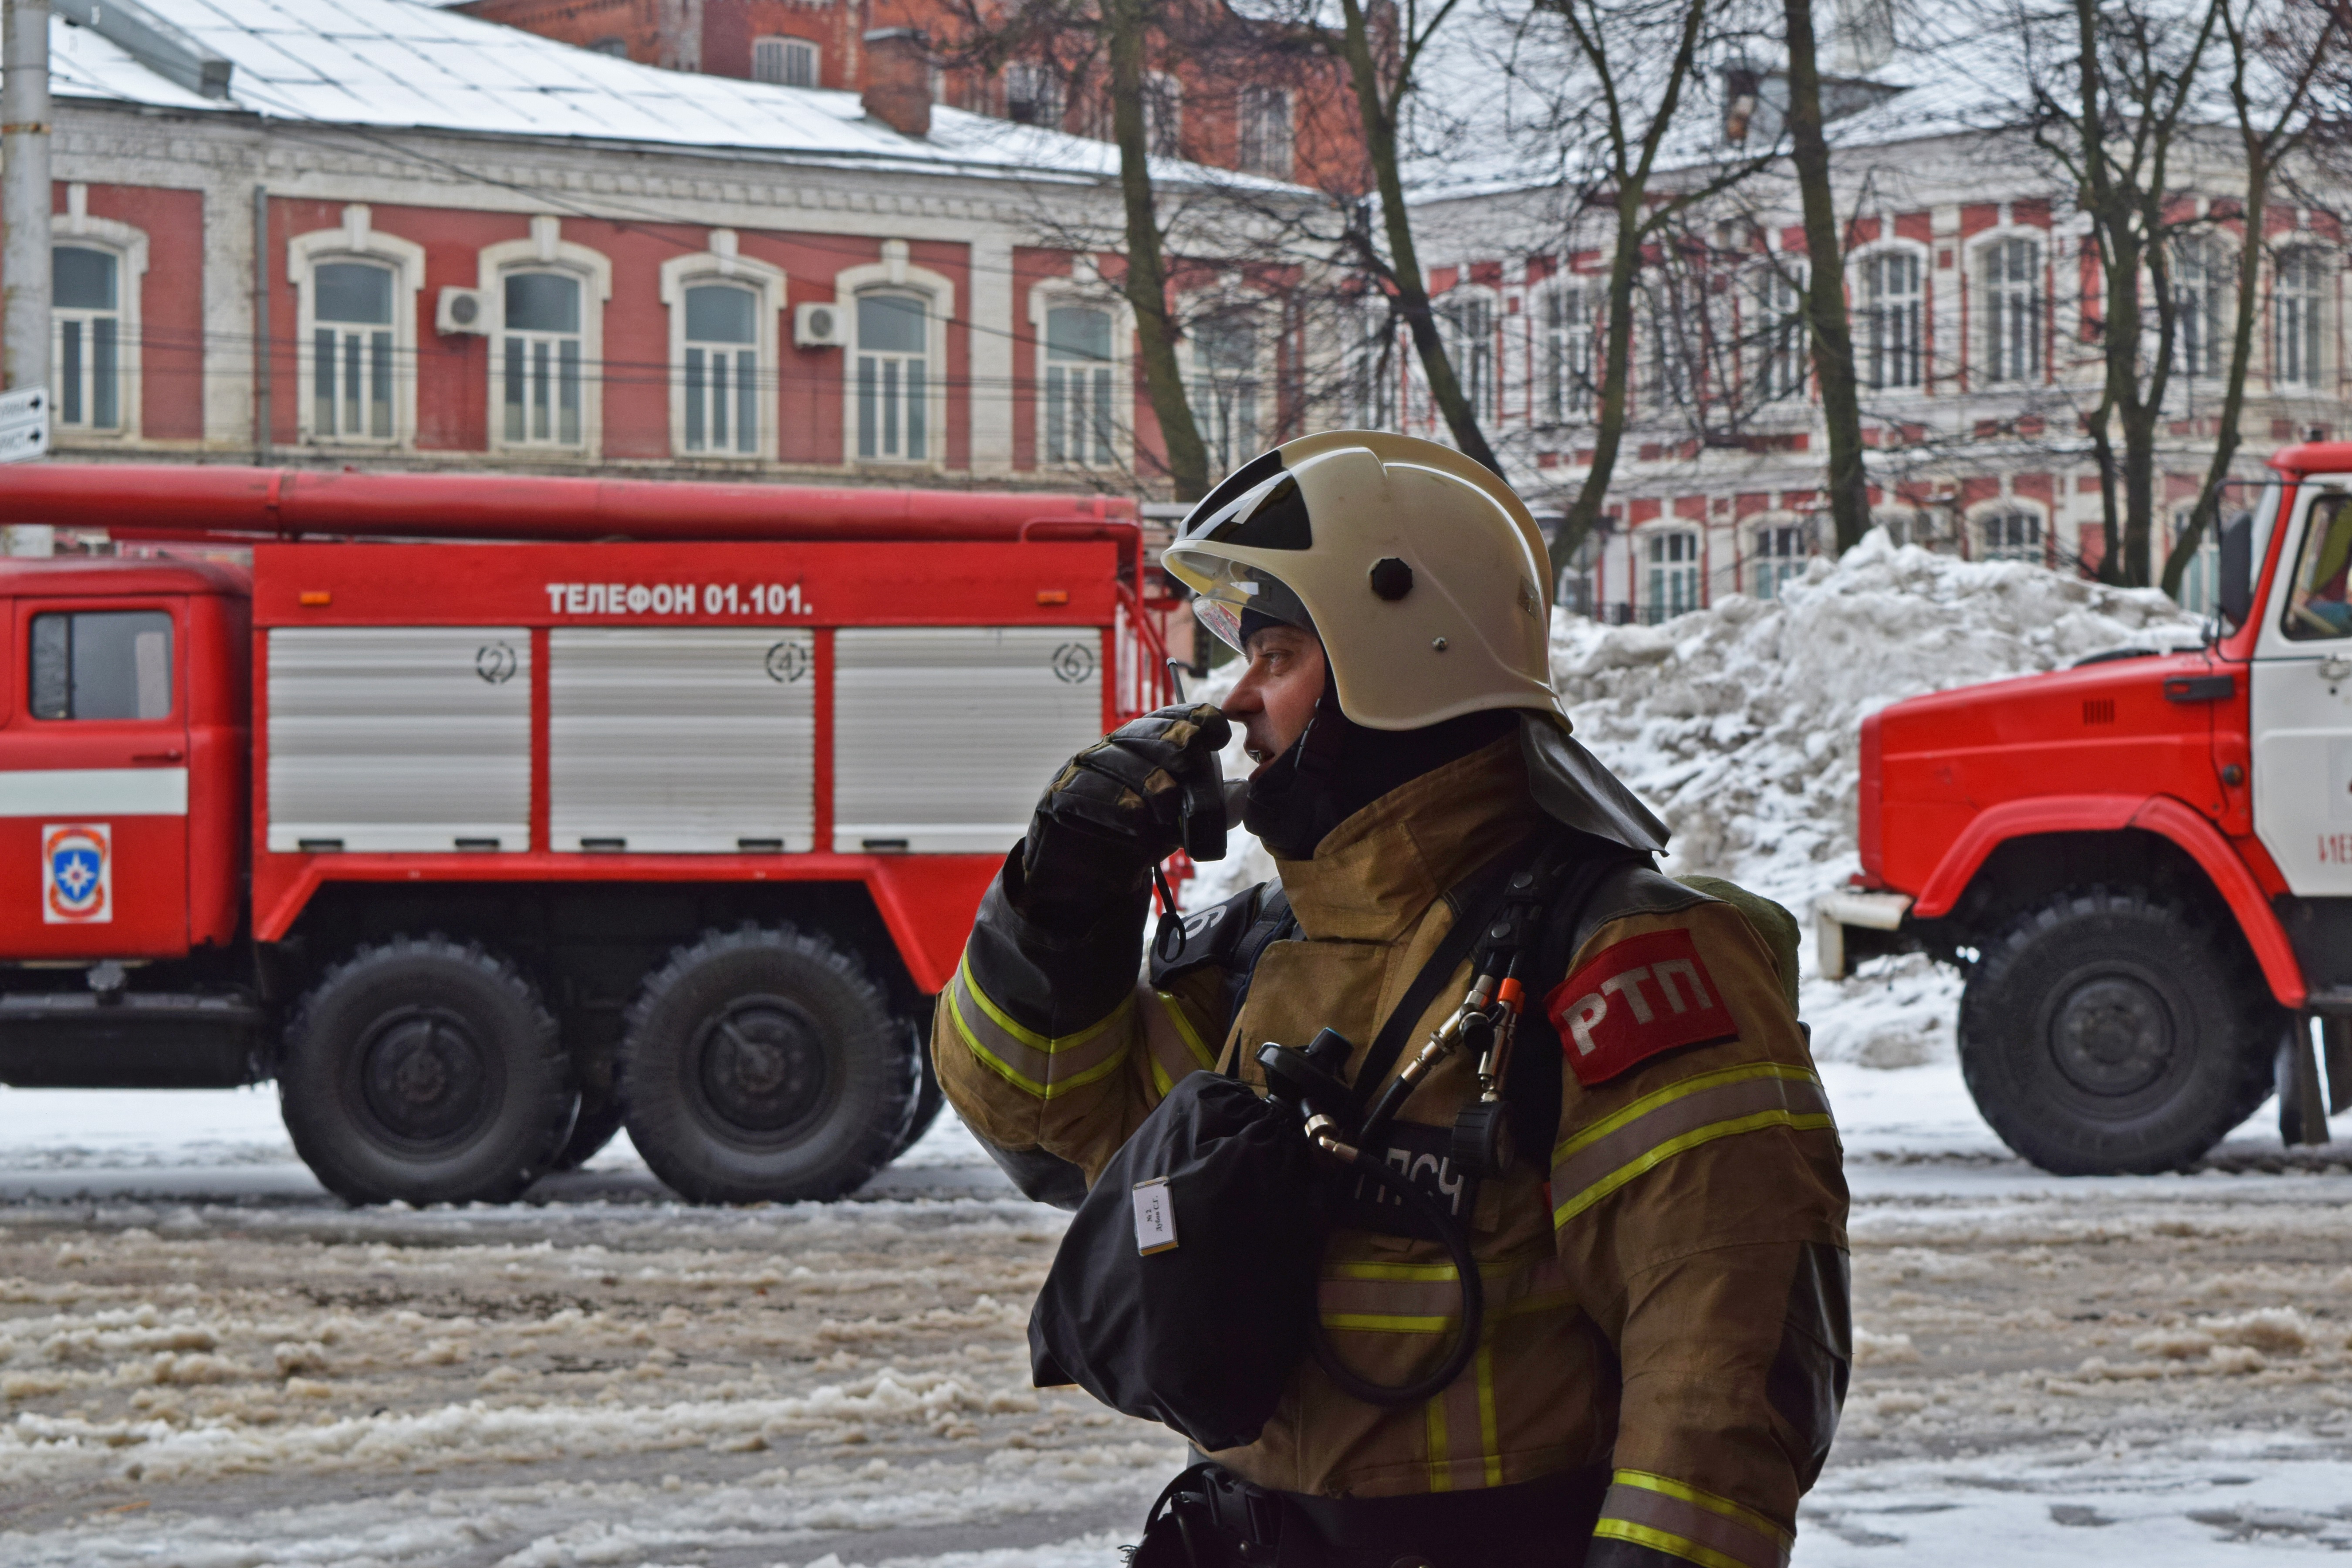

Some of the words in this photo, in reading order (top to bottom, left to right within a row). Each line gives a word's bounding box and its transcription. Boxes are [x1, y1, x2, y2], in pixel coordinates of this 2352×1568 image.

[547, 583, 695, 614] ТЕЛЕФОН
[704, 584, 812, 615] 01.101.
[1562, 959, 1713, 1056] РТП
